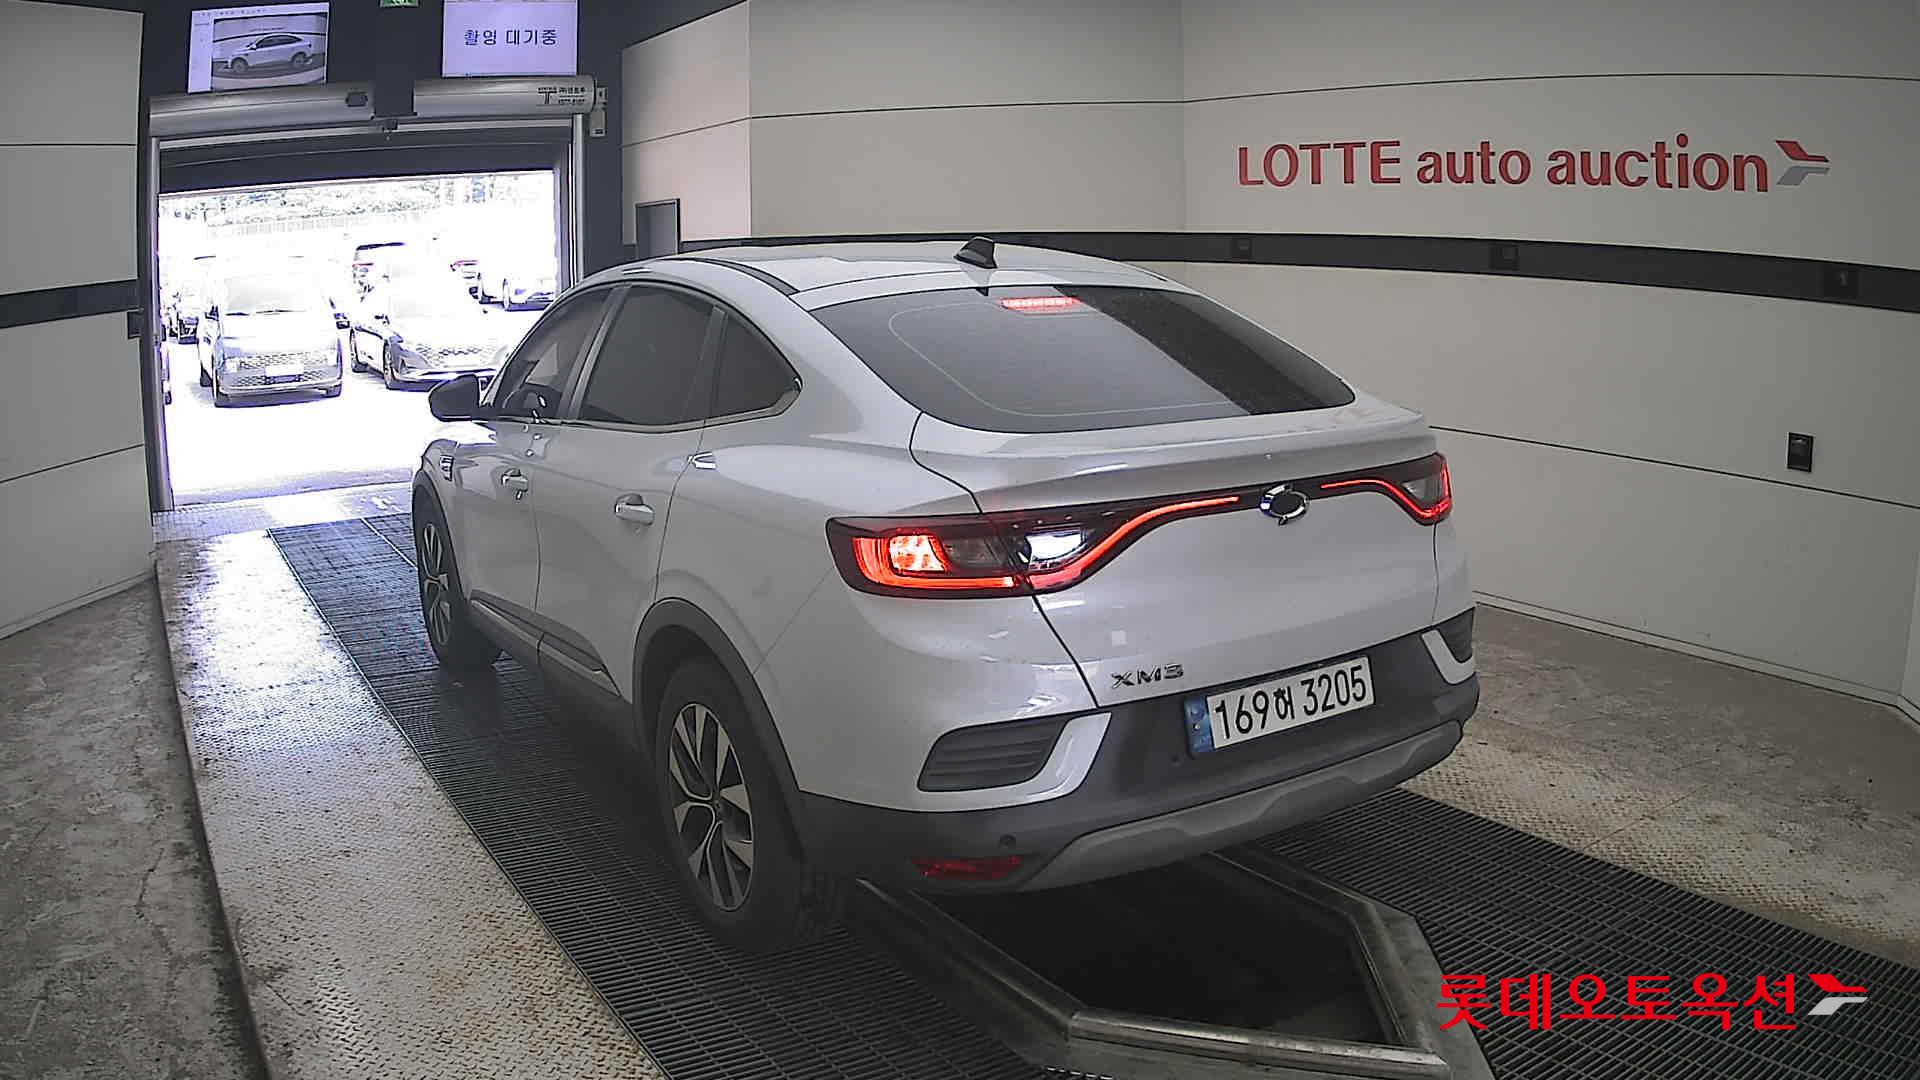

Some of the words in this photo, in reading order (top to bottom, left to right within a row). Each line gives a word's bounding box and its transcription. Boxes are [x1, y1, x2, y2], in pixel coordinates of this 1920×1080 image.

[505, 29, 558, 46] 대기중
[1239, 141, 1400, 187] LOTTE
[1417, 141, 1531, 185] auto
[1548, 134, 1769, 192] auction
[1111, 663, 1185, 689] XM3
[1215, 686, 1295, 740] 169허
[1300, 664, 1367, 716] 3205
